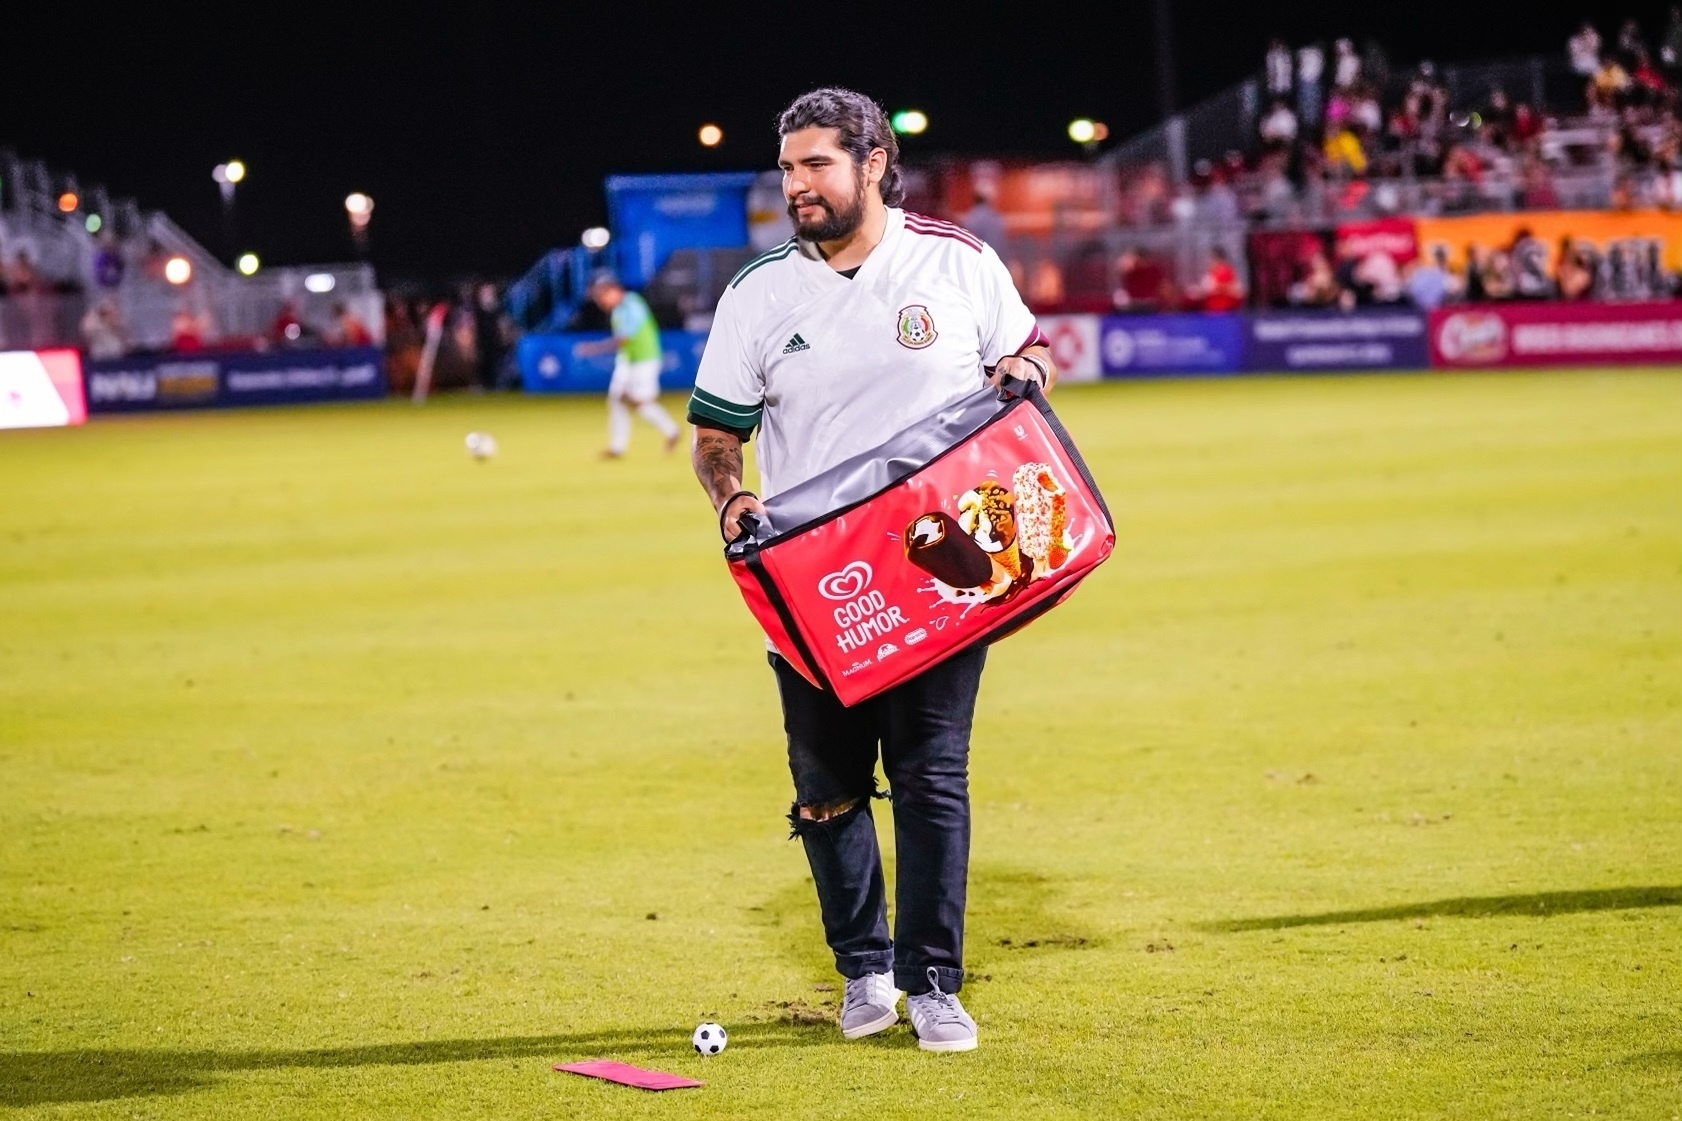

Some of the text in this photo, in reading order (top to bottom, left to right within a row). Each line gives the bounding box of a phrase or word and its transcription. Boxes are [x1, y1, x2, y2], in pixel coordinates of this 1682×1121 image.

[782, 343, 810, 354] adidas
[833, 590, 885, 628] GOOD
[836, 606, 910, 653] HUMOR
[842, 659, 872, 675] MAGNUM
